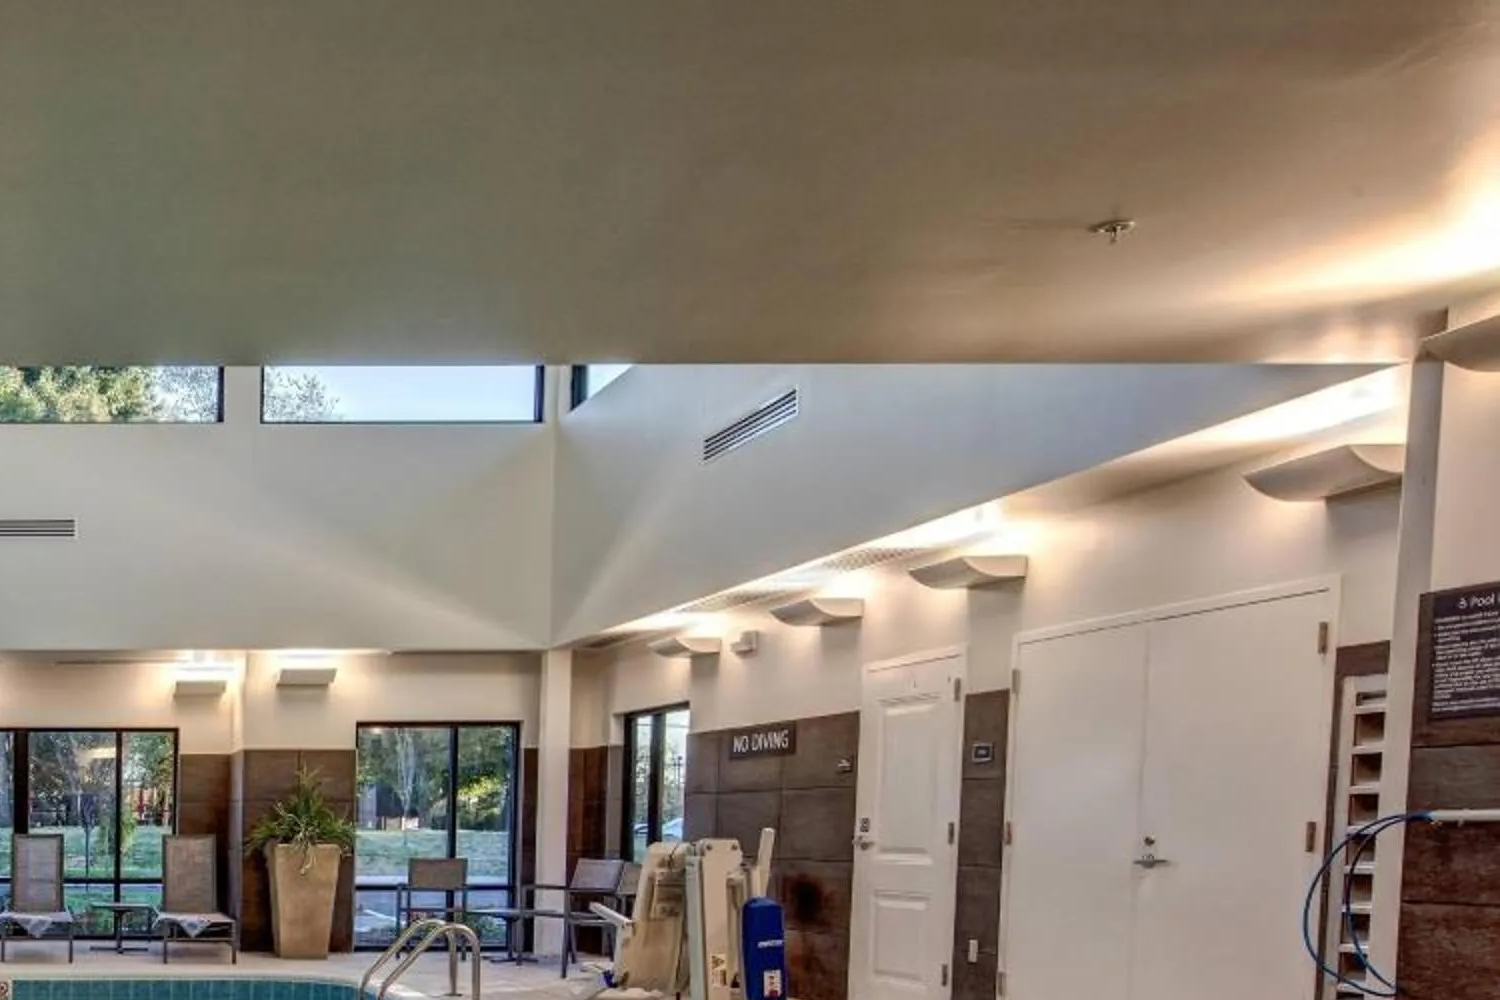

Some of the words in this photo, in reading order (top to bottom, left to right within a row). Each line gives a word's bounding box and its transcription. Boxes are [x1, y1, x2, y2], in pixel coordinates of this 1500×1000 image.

[1470, 592, 1495, 608] Pool
[733, 735, 749, 753] NO
[751, 729, 789, 751] DIVING
